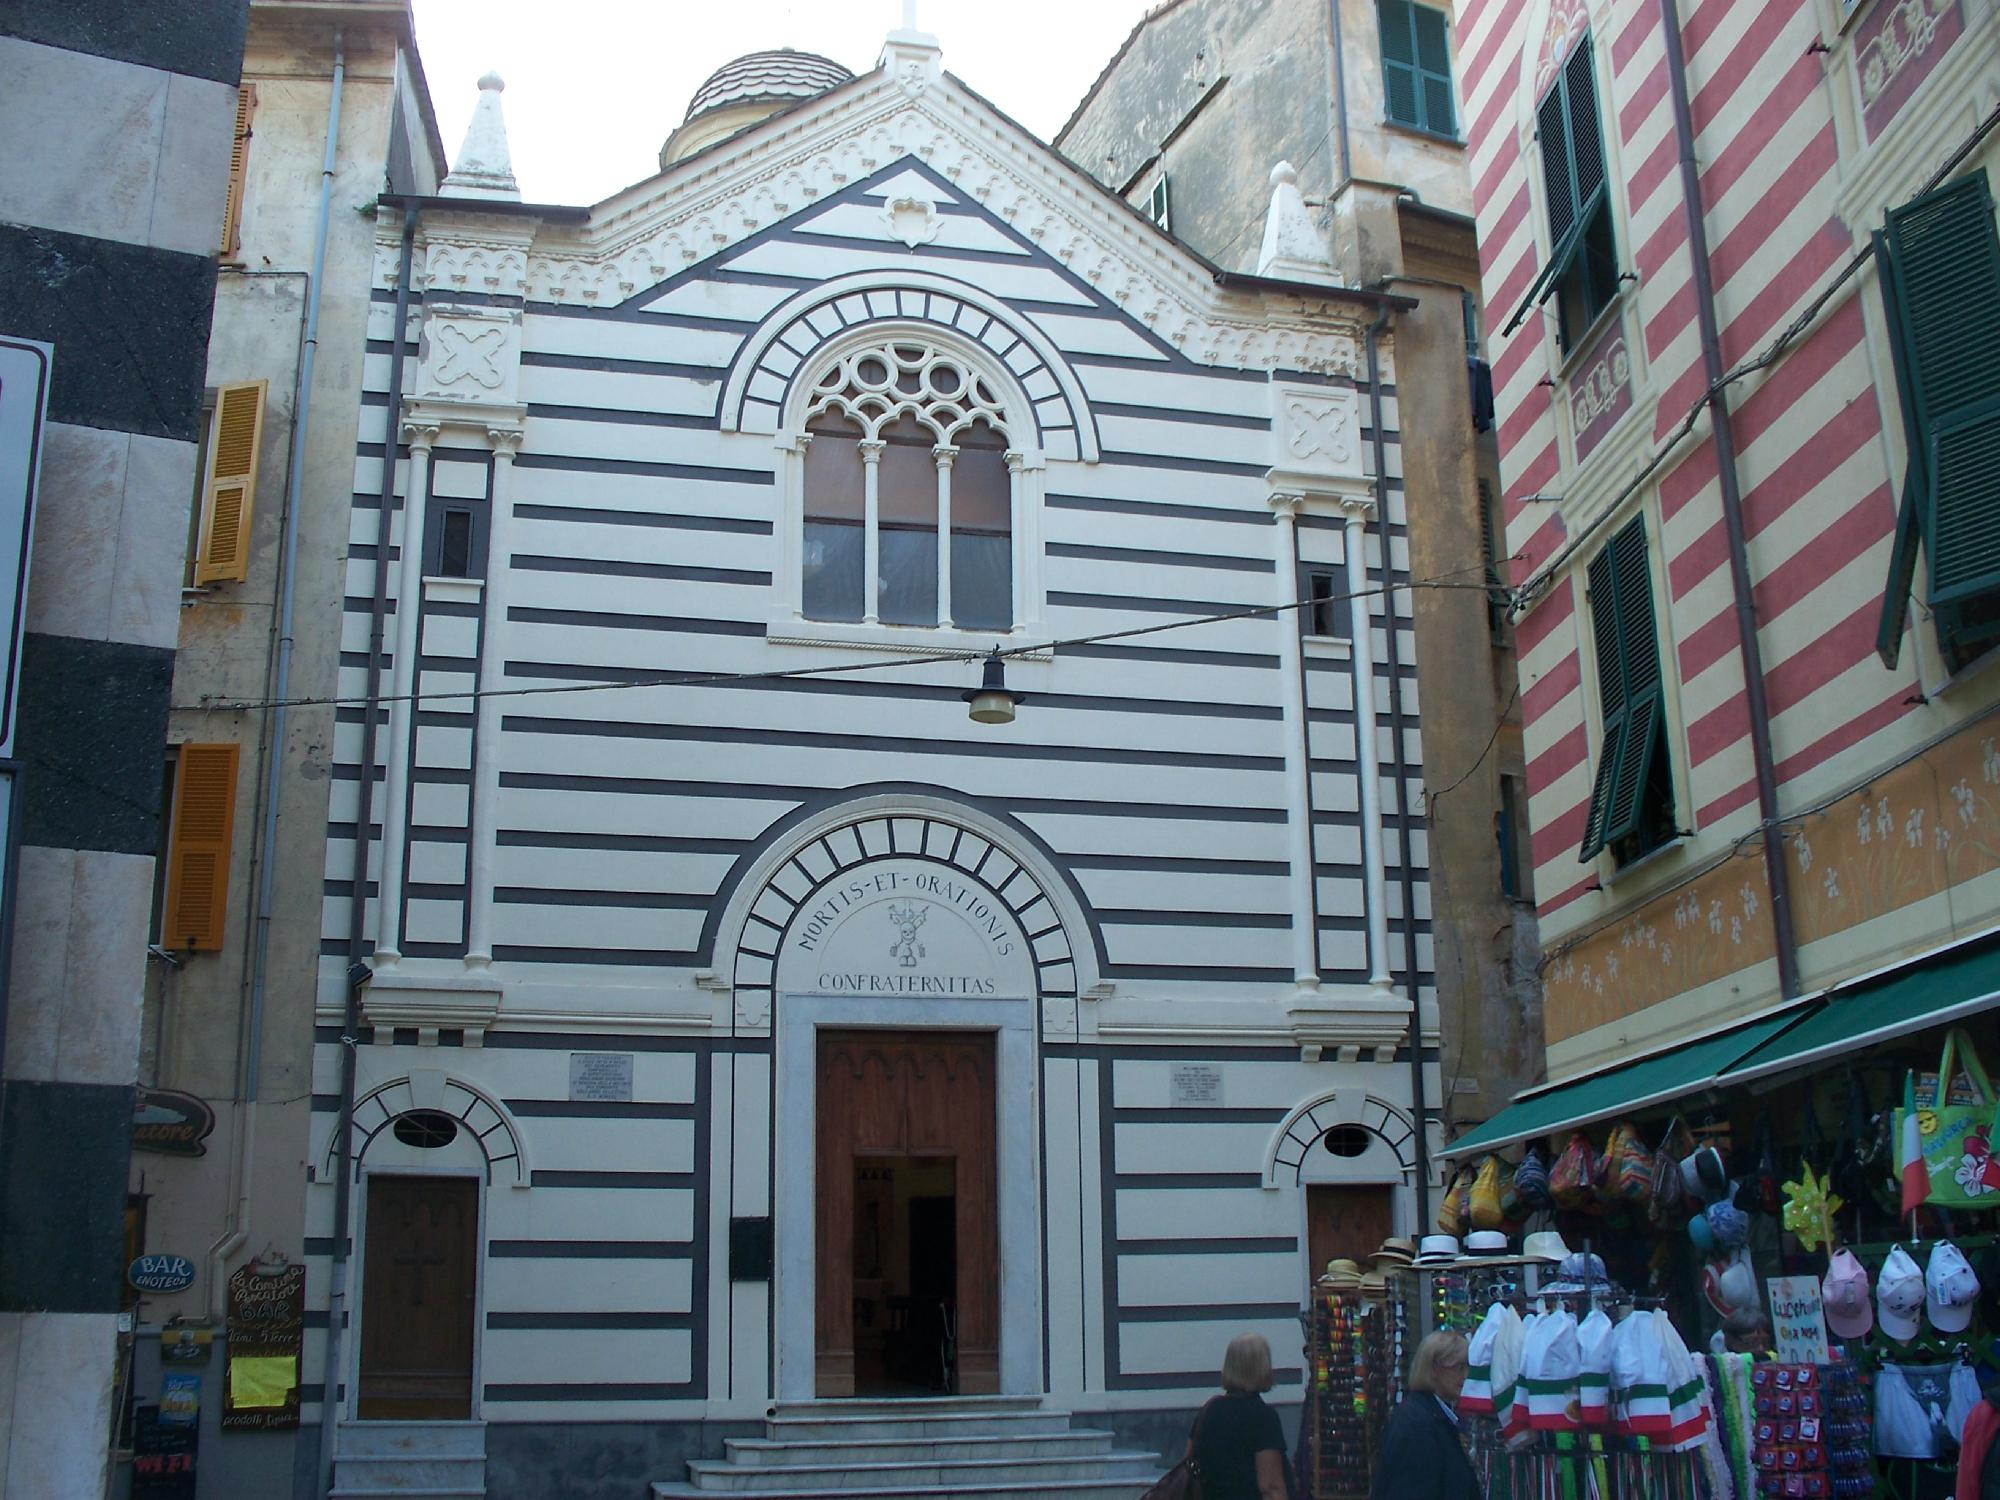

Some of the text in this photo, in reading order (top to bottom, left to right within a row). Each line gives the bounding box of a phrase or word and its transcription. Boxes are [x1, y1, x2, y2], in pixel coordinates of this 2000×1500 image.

[819, 974, 995, 994] CONFRATERNITAS
[141, 1255, 191, 1277] BAR
[136, 1275, 187, 1289] ENOTECA
[240, 1300, 290, 1321] BAR
